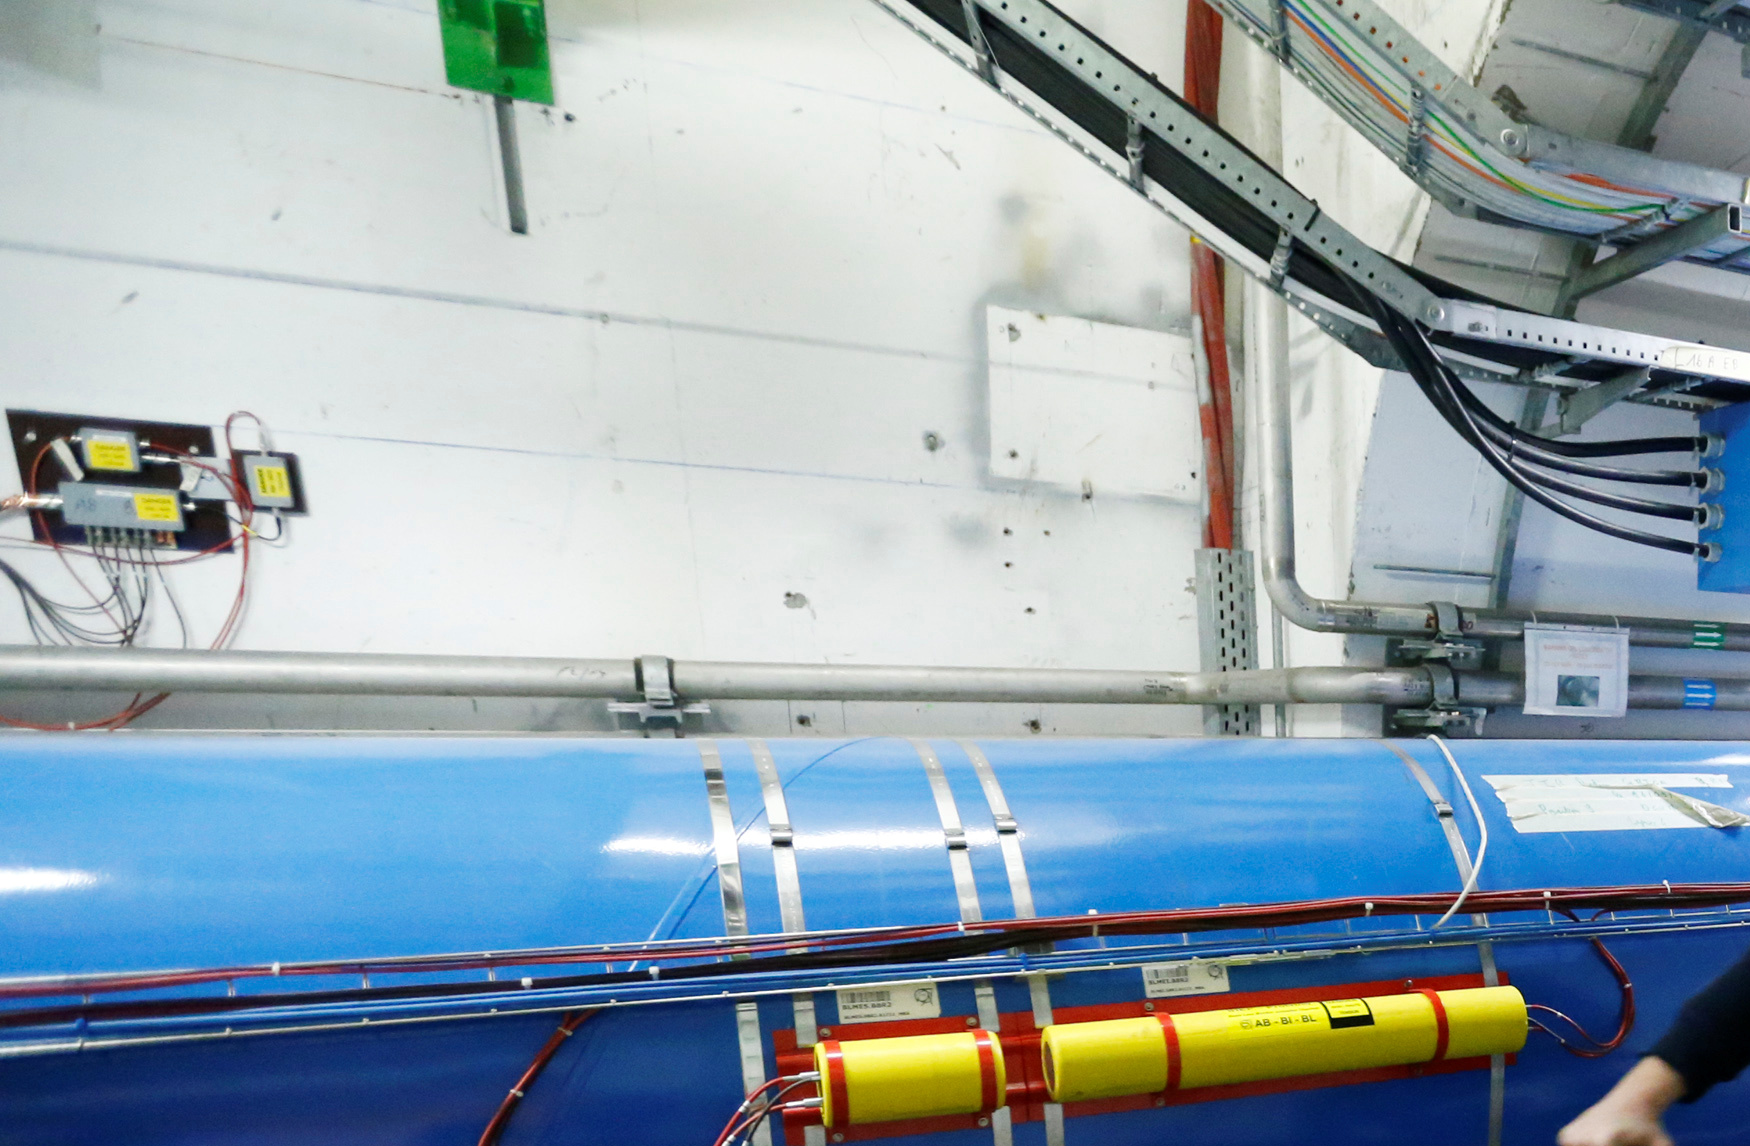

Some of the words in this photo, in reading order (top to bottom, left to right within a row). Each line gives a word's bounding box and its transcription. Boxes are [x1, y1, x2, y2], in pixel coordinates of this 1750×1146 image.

[1255, 1018, 1271, 1027] AB
[1281, 1016, 1292, 1025] BI
[1302, 1014, 1317, 1023] BL
